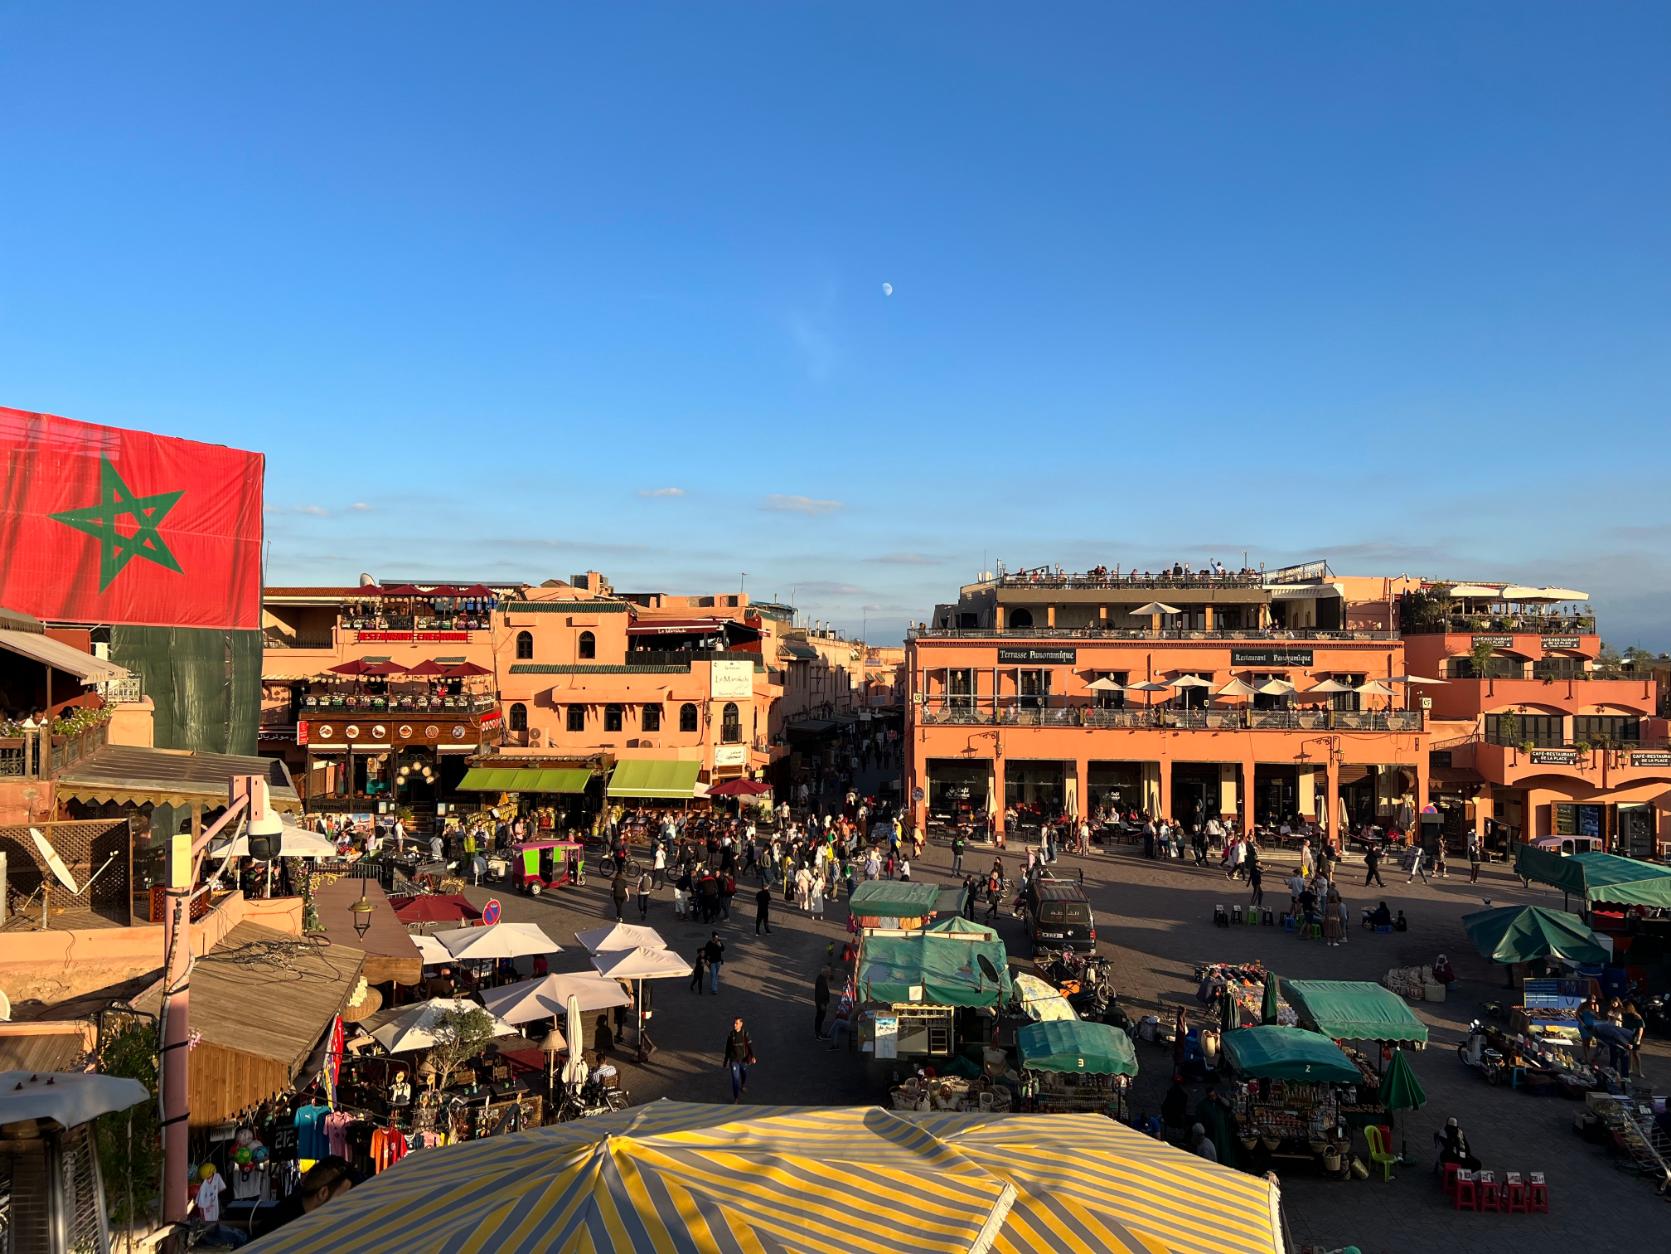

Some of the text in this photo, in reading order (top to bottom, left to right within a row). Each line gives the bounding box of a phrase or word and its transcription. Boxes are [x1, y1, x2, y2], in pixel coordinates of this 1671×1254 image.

[1000, 650, 1074, 662] Terrasse Panoramique
[1078, 1058, 1084, 1068] 3
[1305, 1064, 1311, 1073] 2
